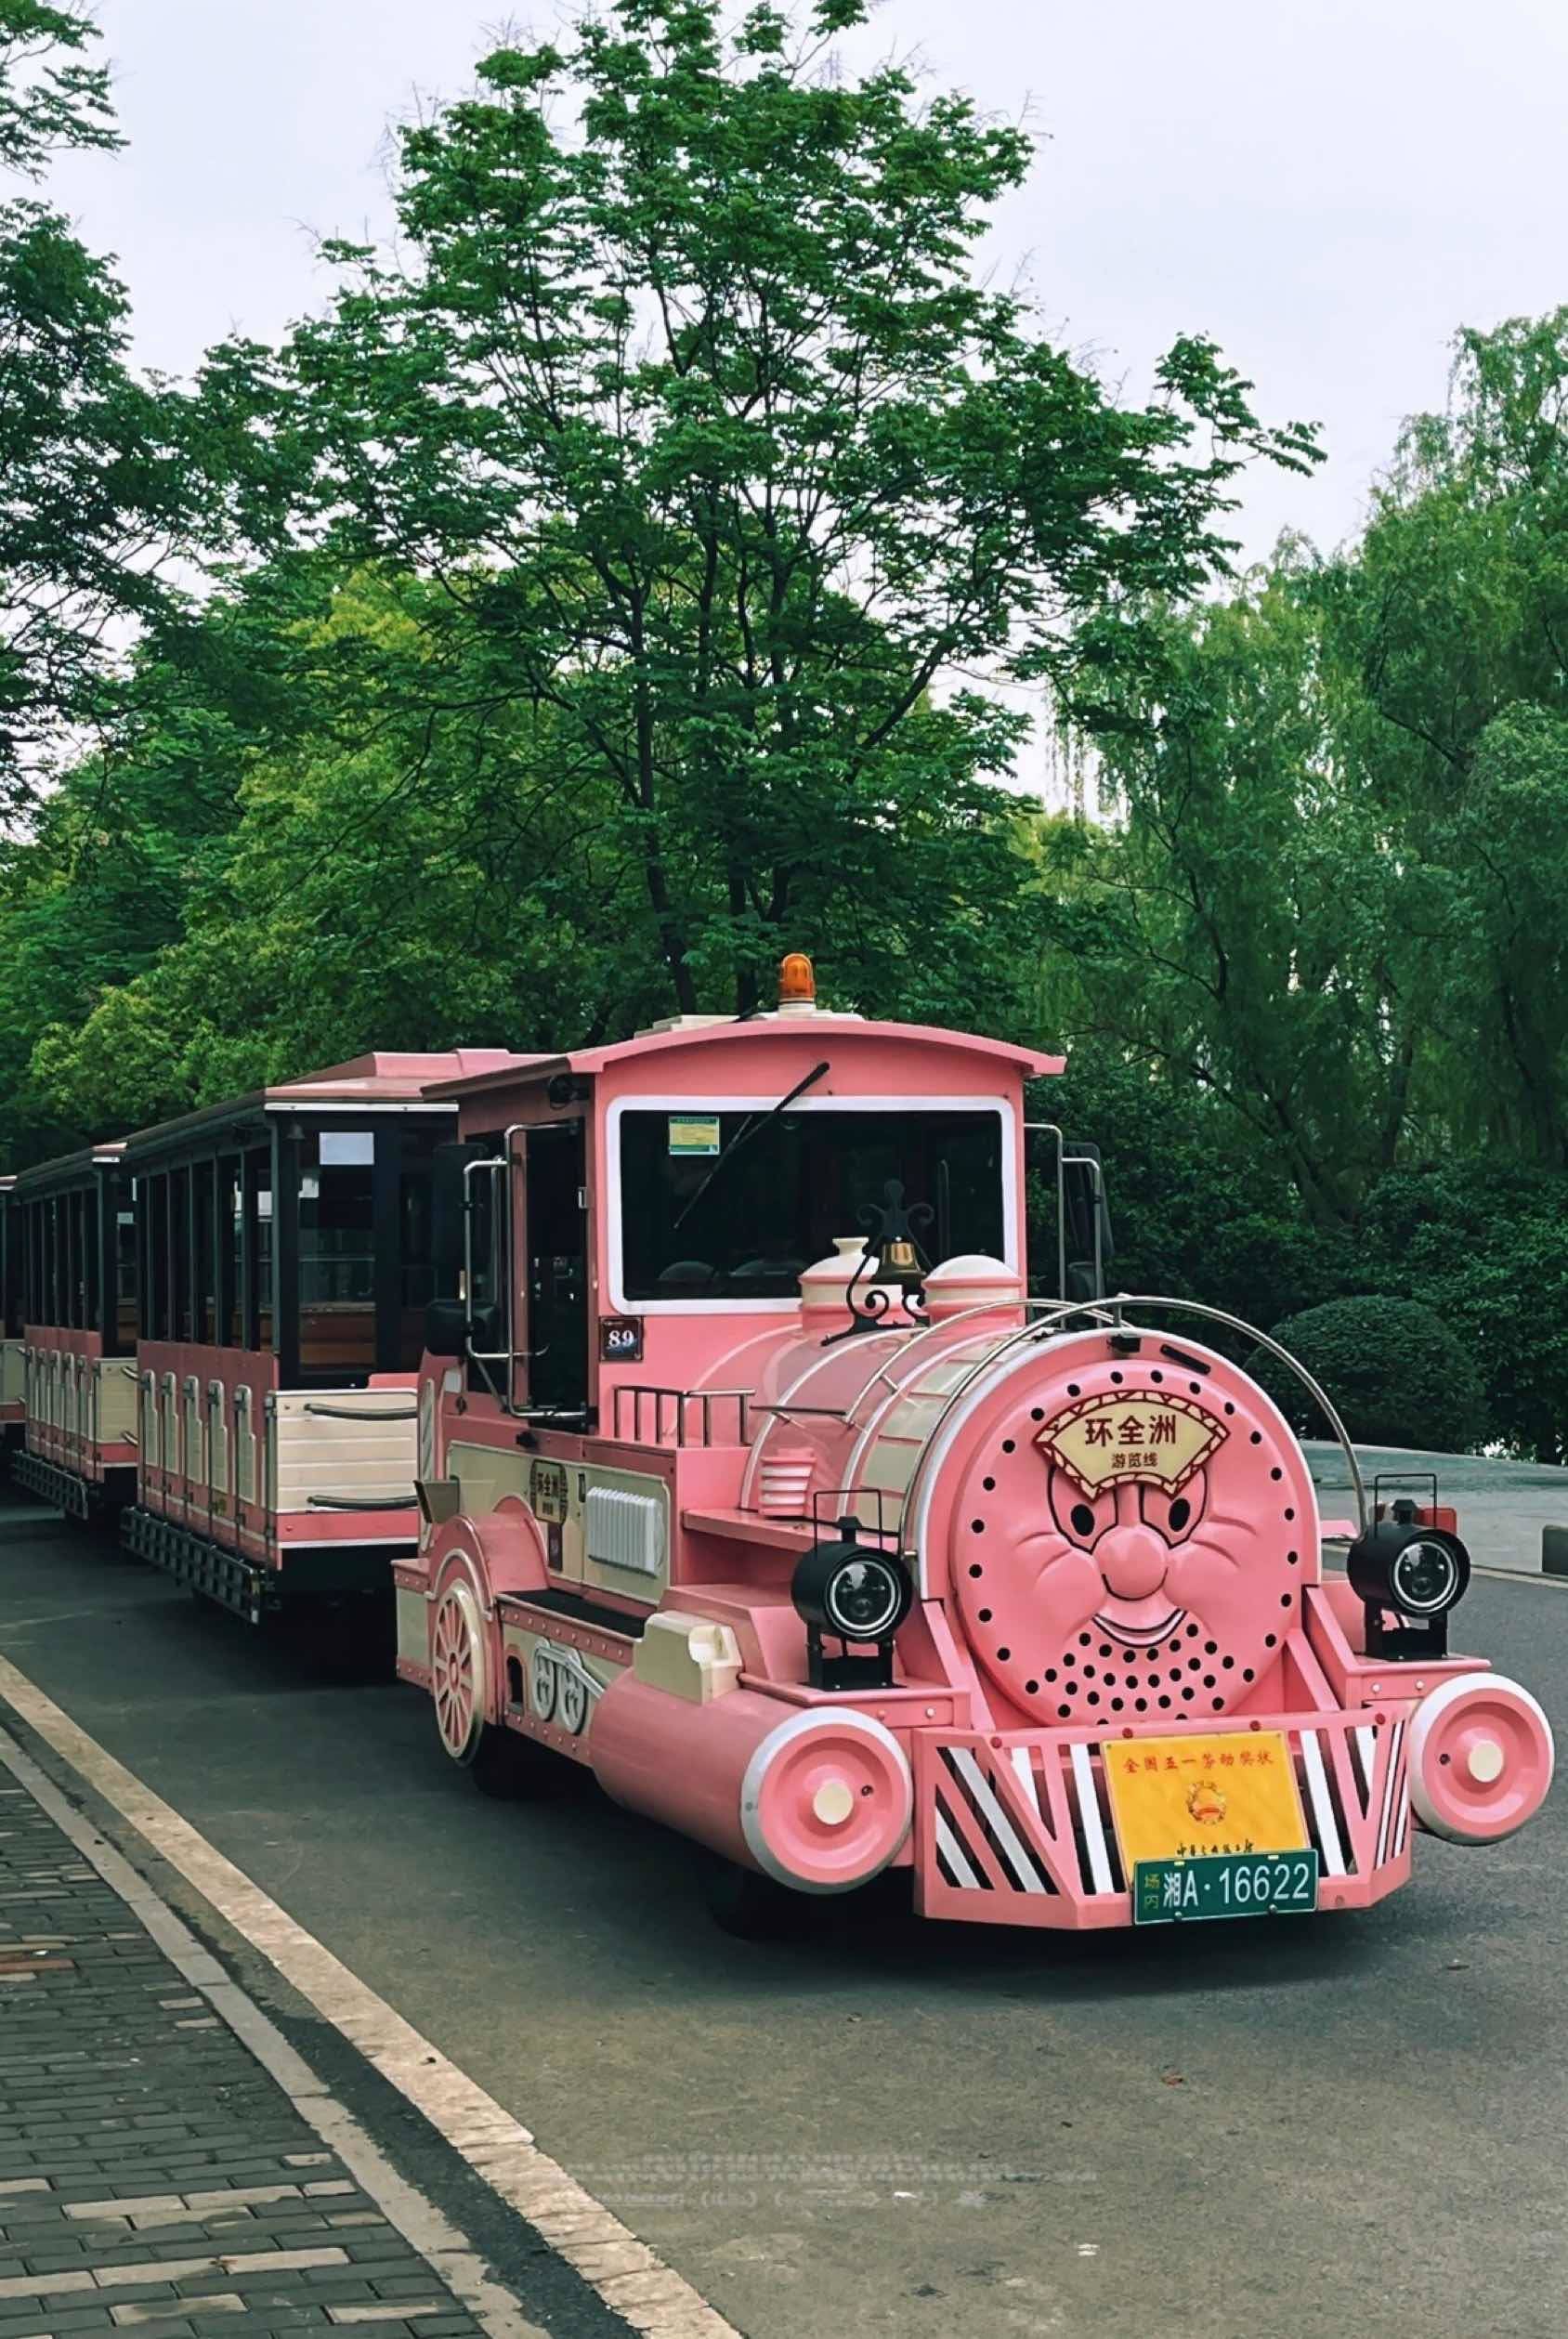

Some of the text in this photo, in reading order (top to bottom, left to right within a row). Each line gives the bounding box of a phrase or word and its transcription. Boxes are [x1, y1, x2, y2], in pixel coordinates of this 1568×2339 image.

[609, 1330, 634, 1347] 89
[1085, 1415, 1176, 1447] 环全洲
[1112, 1454, 1158, 1468] 游览线
